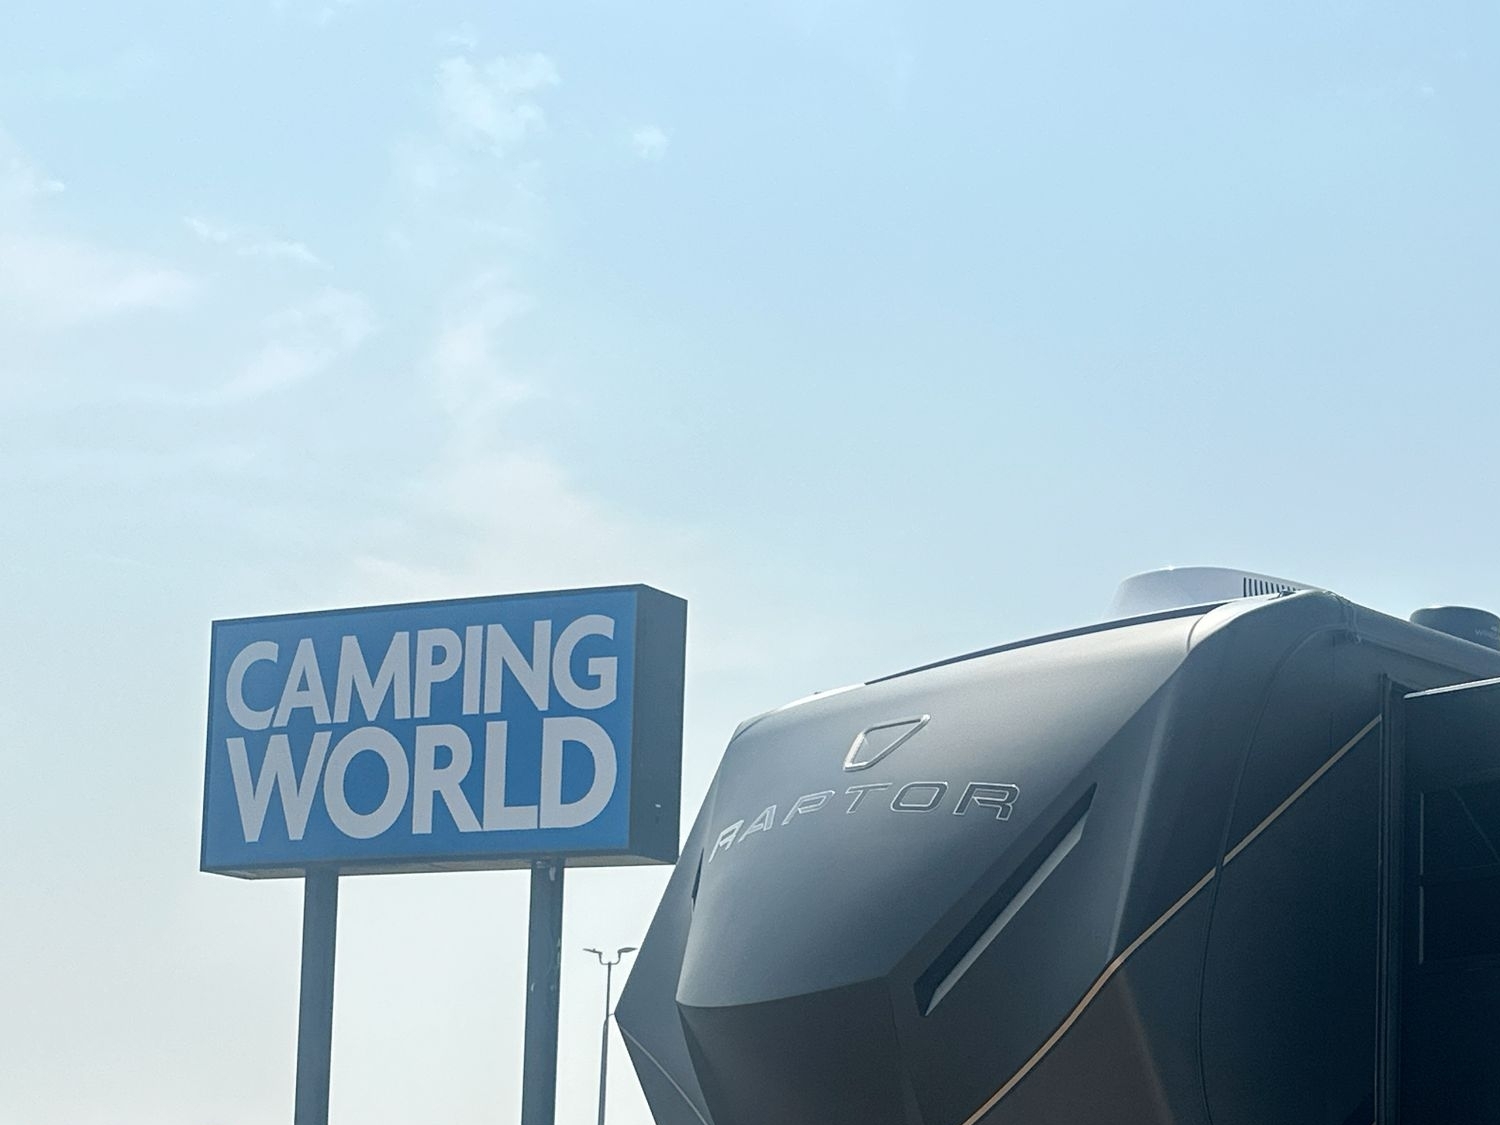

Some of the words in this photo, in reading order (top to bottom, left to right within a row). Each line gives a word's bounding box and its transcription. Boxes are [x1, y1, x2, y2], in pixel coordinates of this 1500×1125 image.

[226, 614, 617, 730] CAMPING
[226, 716, 617, 843] WORLD
[708, 781, 1020, 863] RAPTOR
